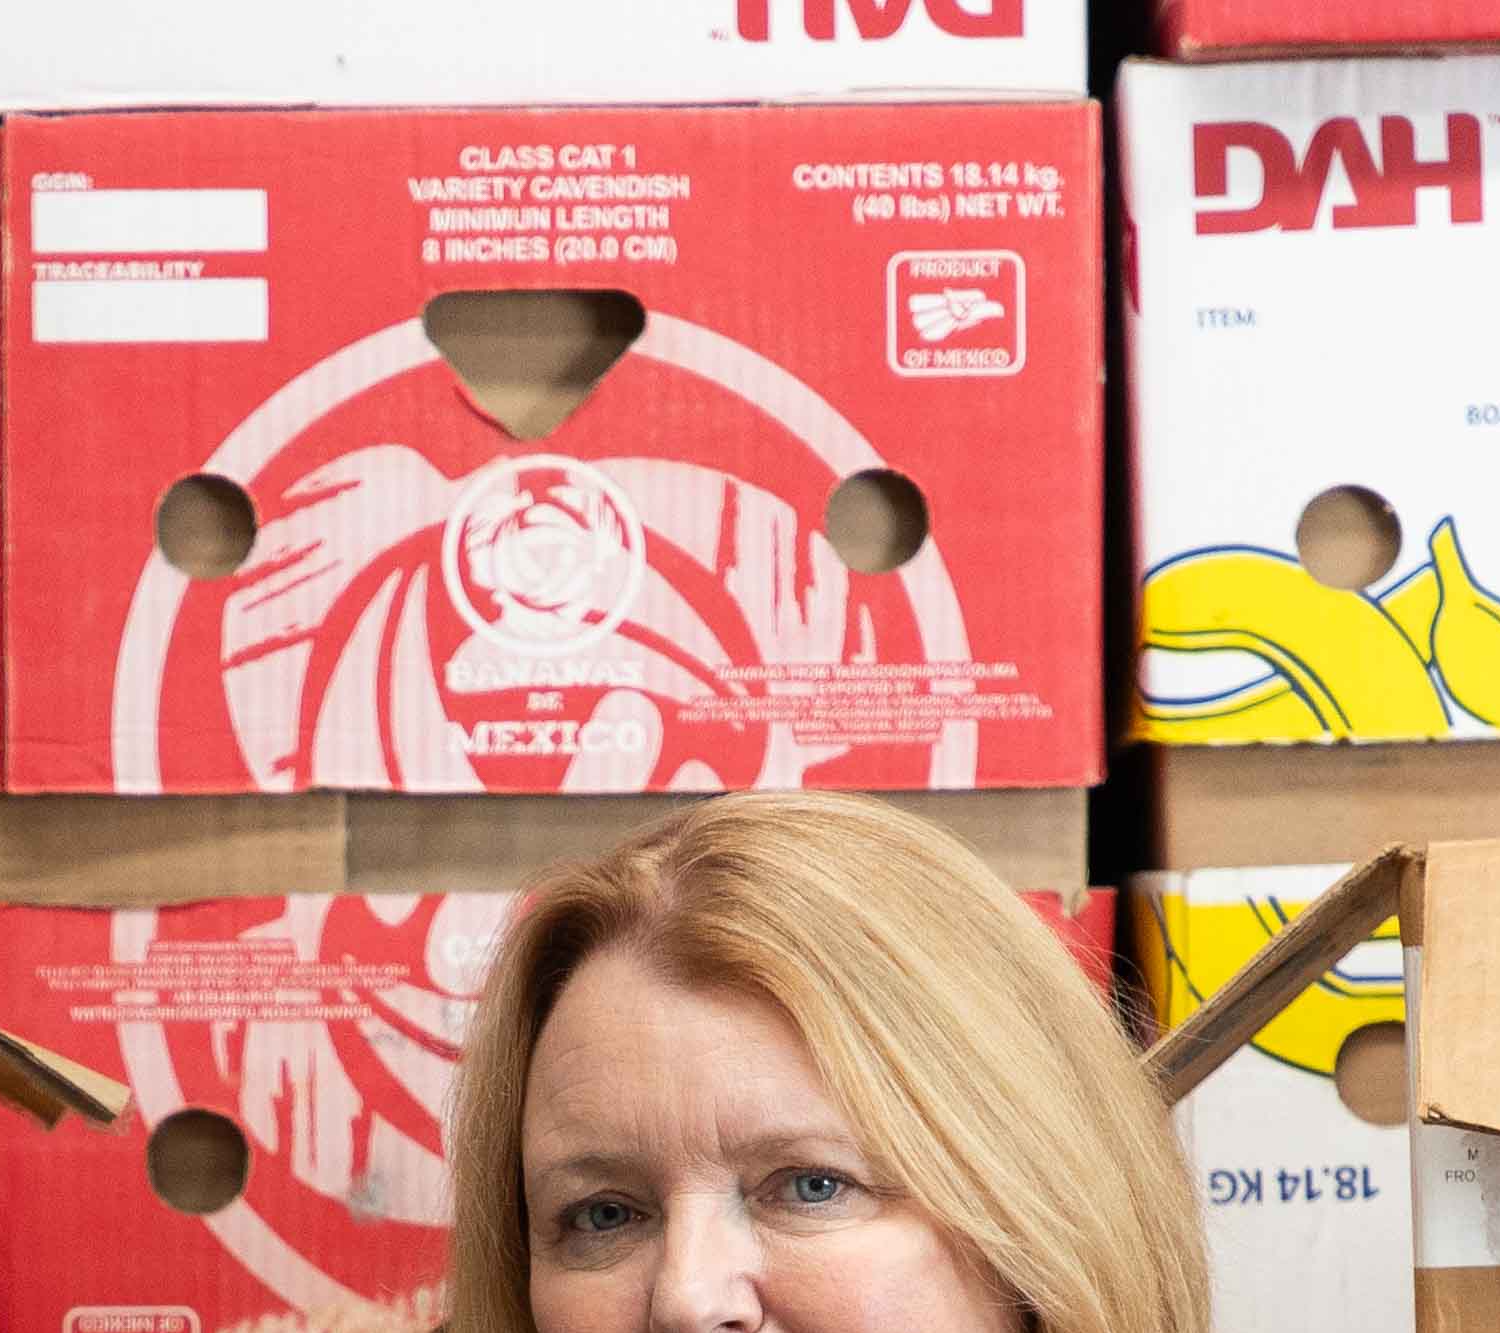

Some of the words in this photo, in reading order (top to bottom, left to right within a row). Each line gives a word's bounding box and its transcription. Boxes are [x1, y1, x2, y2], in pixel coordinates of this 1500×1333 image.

[460, 145, 554, 171] CLASS
[559, 144, 616, 169] CAT
[622, 144, 636, 168] 1
[408, 176, 524, 201] VARIETY
[530, 174, 690, 199] CAVENDISH
[792, 163, 943, 189] CONTENTS
[950, 162, 1018, 187] 18.14
[556, 205, 669, 230] LENGTH
[852, 194, 894, 223] (40
[900, 194, 950, 223] lbs)
[956, 193, 1011, 216] NET
[1016, 192, 1064, 215] WT.
[445, 236, 549, 262] INCHES
[623, 235, 677, 264] CM)
[909, 259, 1000, 278] PRODUCT
[1197, 309, 1256, 329] ITEM
[933, 349, 1009, 368] MEXICO
[453, 660, 643, 686] BANANAS
[449, 720, 646, 755] MEXICO
[1208, 1168, 1264, 1205] KG
[1276, 1166, 1378, 1203] 18.14
